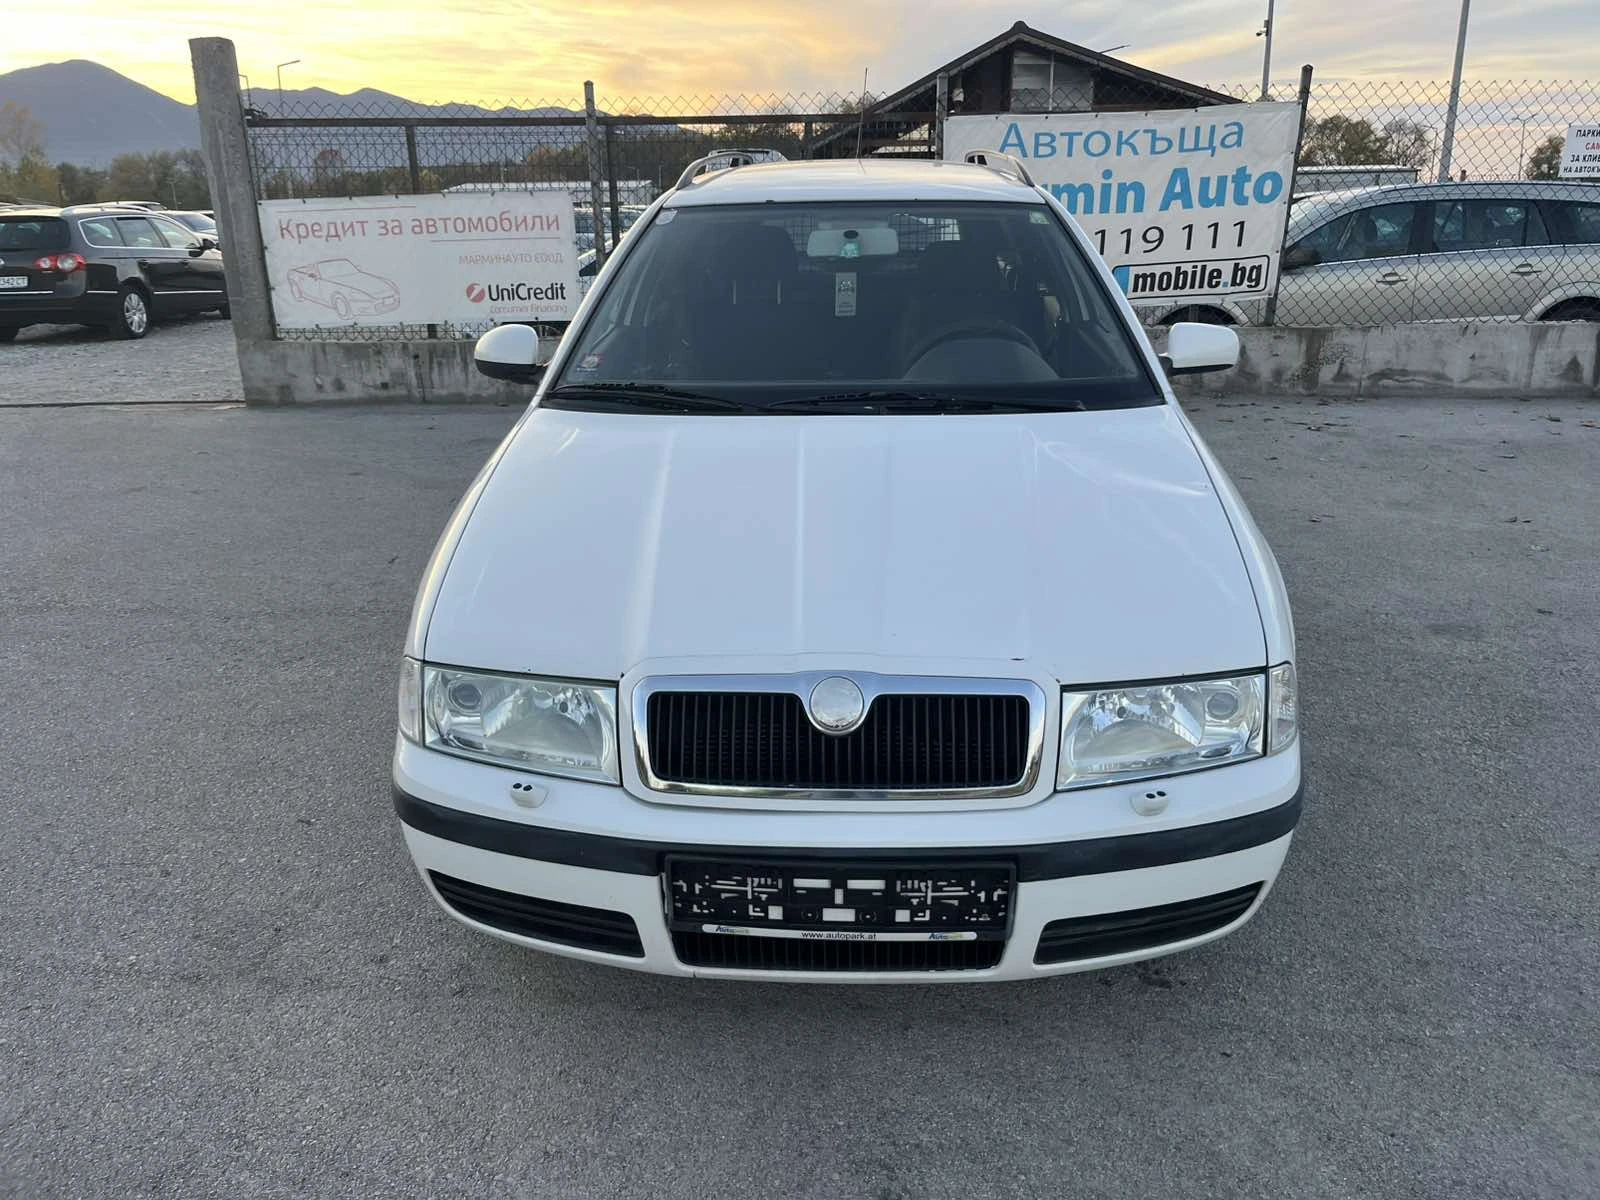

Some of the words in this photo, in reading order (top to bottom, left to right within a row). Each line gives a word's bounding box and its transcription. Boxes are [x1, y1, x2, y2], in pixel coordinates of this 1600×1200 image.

[1000, 121, 1244, 158] Автокъща
[1040, 168, 1146, 216] min
[1159, 166, 1283, 211] Auto
[278, 219, 369, 244] Кредит
[377, 219, 403, 236] за
[411, 210, 560, 235] автомобили
[1094, 226, 1165, 256] 119
[1182, 220, 1247, 250] 111
[487, 282, 566, 302] UniCredit
[1132, 262, 1263, 293] mobile.bg
[801, 930, 877, 942] www.autopark.at
